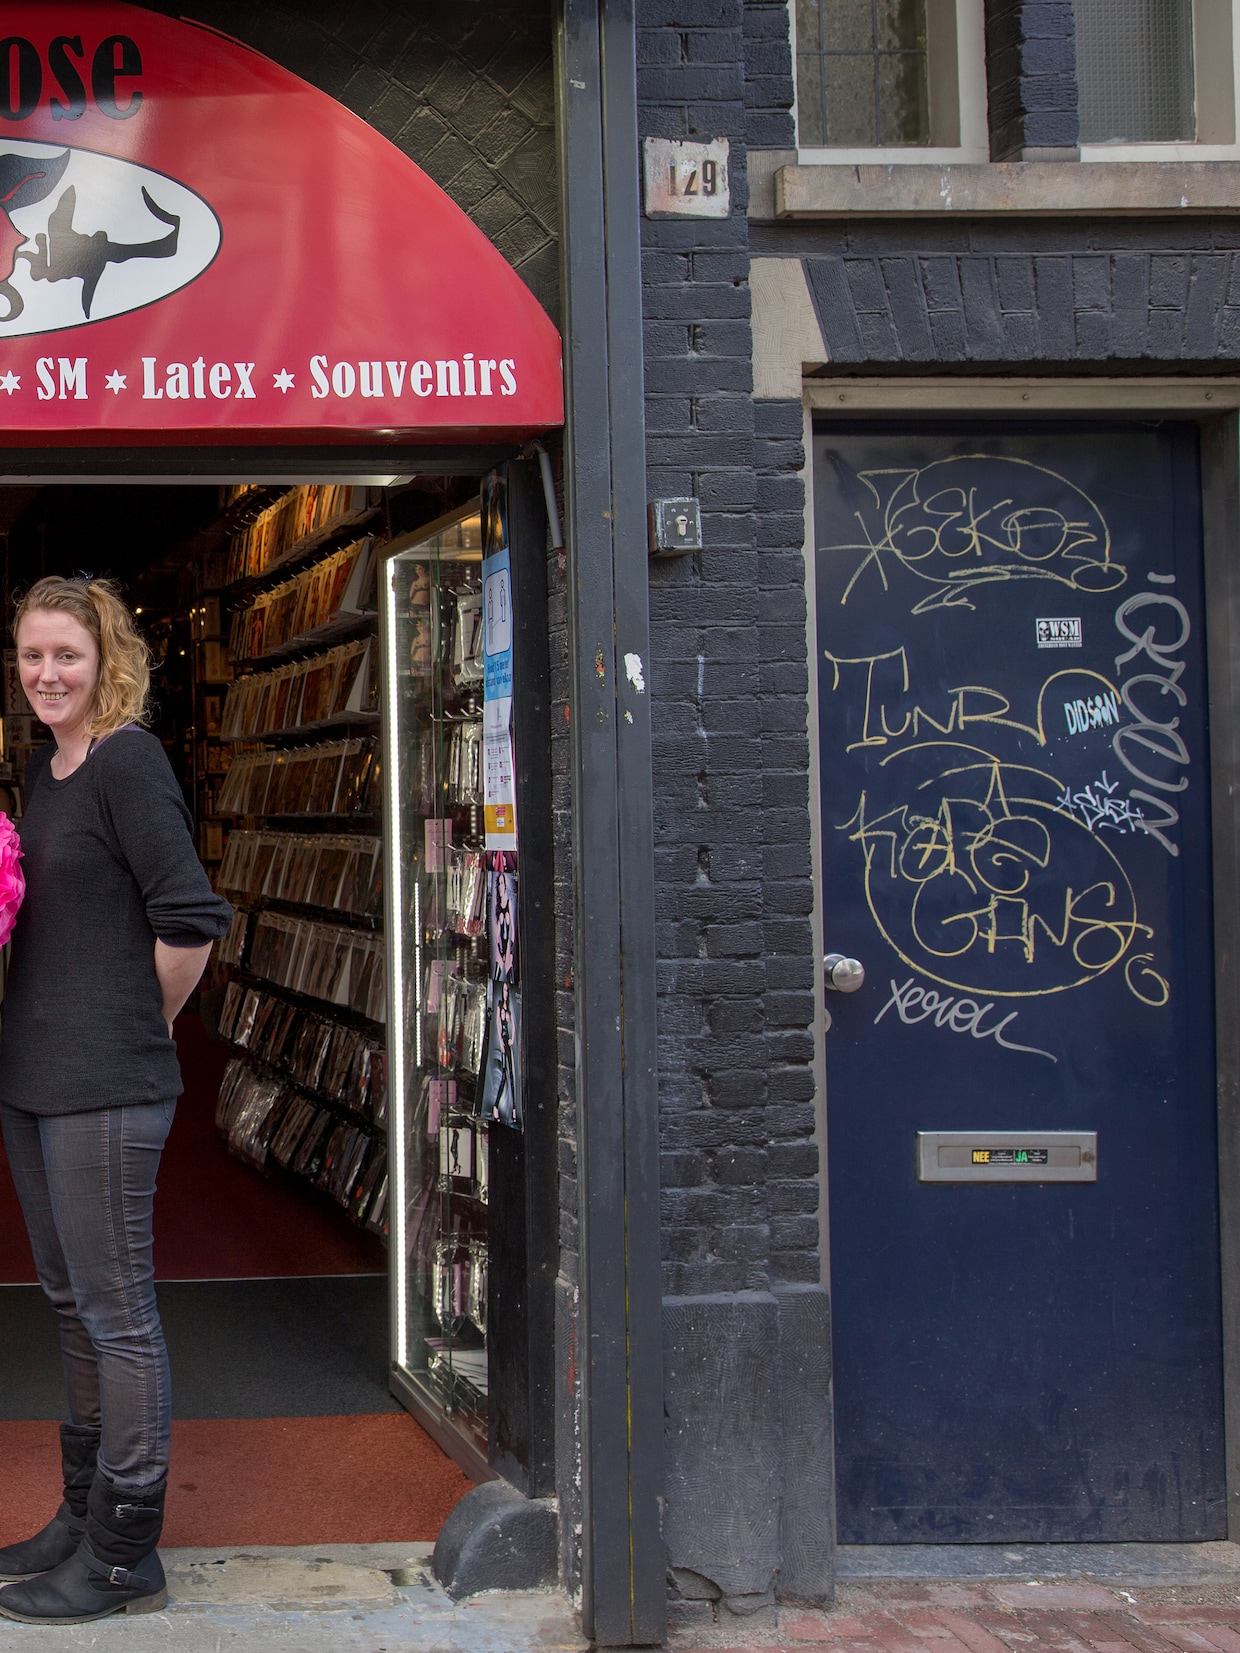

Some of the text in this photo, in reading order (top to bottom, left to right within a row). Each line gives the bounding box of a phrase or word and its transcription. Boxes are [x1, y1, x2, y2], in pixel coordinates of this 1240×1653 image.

[667, 158, 718, 197] 129
[36, 357, 88, 400] SM
[142, 356, 257, 400] Latex
[309, 352, 518, 398] Souvenirs
[1049, 620, 1080, 637] WSM
[973, 1151, 990, 1163] NEE
[1016, 1151, 1028, 1162] JA
